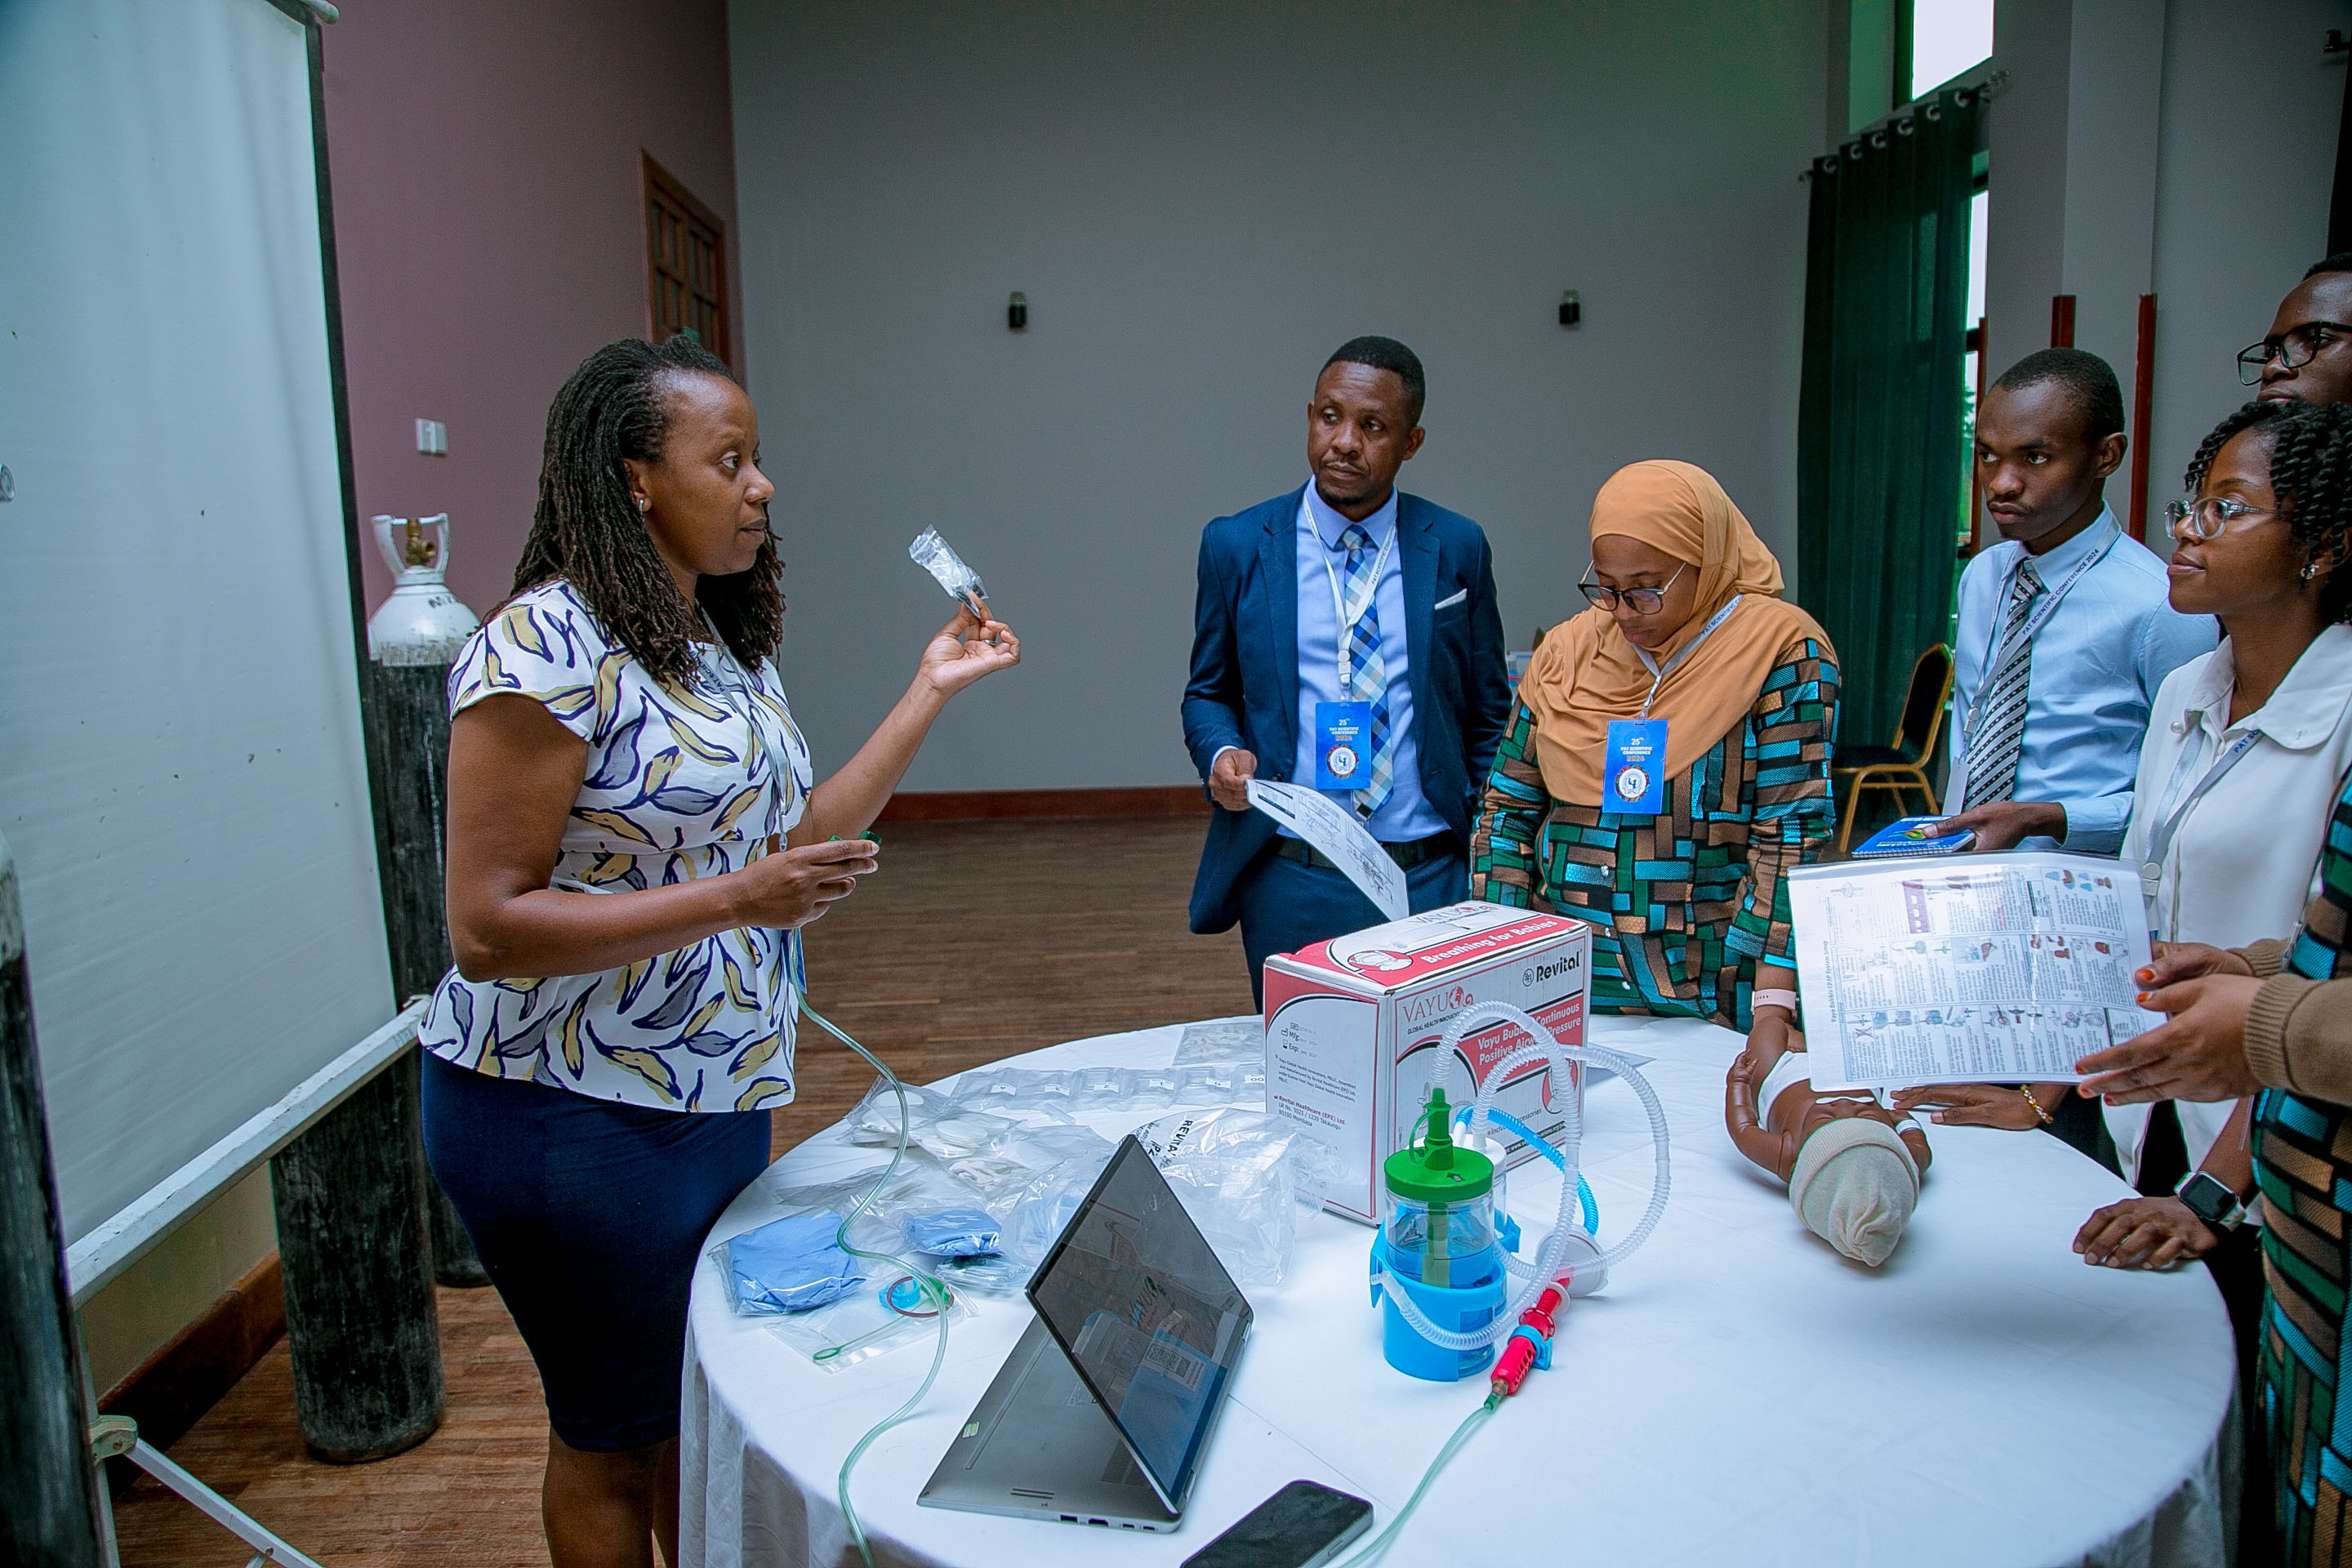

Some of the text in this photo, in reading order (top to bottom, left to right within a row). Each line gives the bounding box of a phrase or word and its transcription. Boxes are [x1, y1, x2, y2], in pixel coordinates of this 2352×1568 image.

[2022, 549, 2100, 635] PAT SCIENTIFIC CONFERENCE 2024
[1701, 604, 1736, 635] PAT SCIENTIFIC
[713, 678, 726, 692] PAT
[2234, 737, 2248, 753] PAT
[1420, 920, 1558, 964] Breathing for Babies
[1536, 951, 1579, 982] Revital
[1402, 991, 1449, 1022] VAYU
[1407, 1025, 1423, 1035] GLOBAL
[1424, 1018, 1439, 1029] HEALTH
[1477, 1003, 1580, 1050] Vayu Bubb Continuous
[1479, 1017, 1581, 1065] Positive Airw Pressure
[1279, 1095, 1295, 1106] Revital
[1295, 1102, 1321, 1116] Healthcare
[1321, 1111, 1335, 1122] (EPZ)
[1293, 1107, 1304, 1116] 5025
[1308, 1113, 1319, 1122] 1239
[1293, 1114, 1313, 1127] Mombasa
[1167, 1120, 1194, 1156] REVITA
